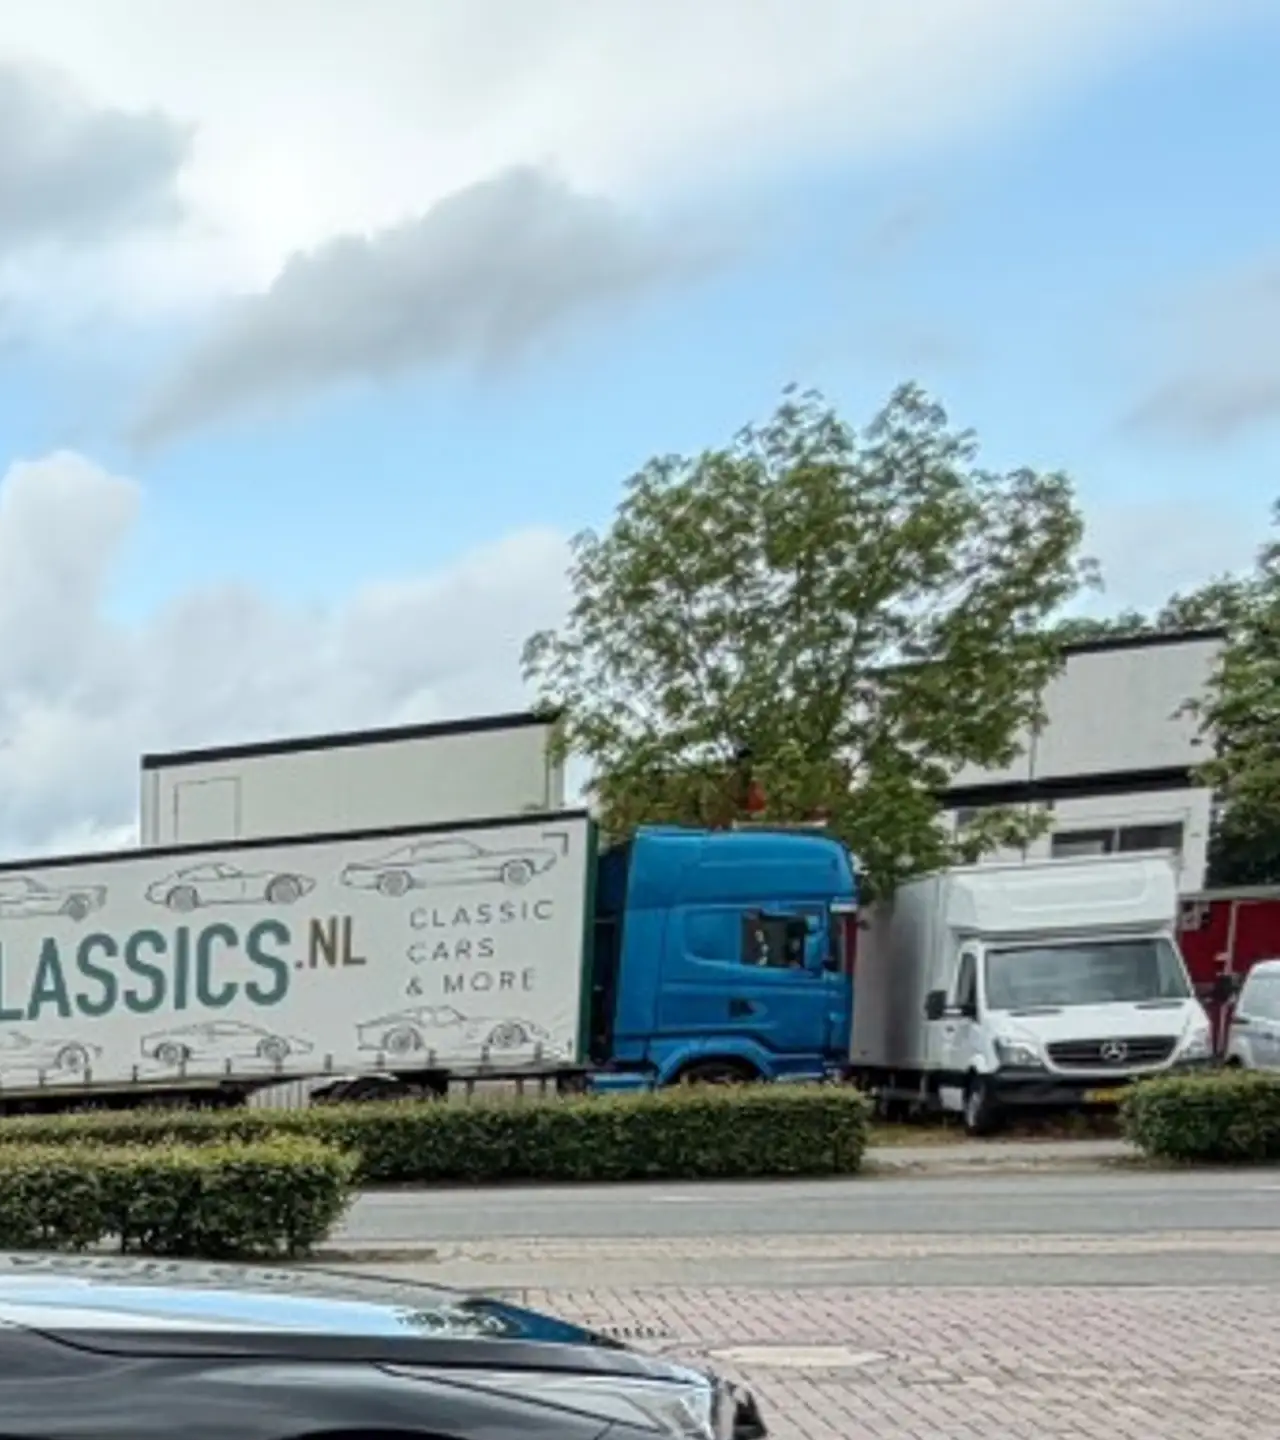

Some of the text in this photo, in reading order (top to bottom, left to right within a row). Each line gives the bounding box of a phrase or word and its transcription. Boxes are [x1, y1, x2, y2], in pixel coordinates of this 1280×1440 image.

[409, 900, 554, 930] CLASSIC
[406, 937, 495, 965] CARS
[405, 966, 536, 996] & MORE
